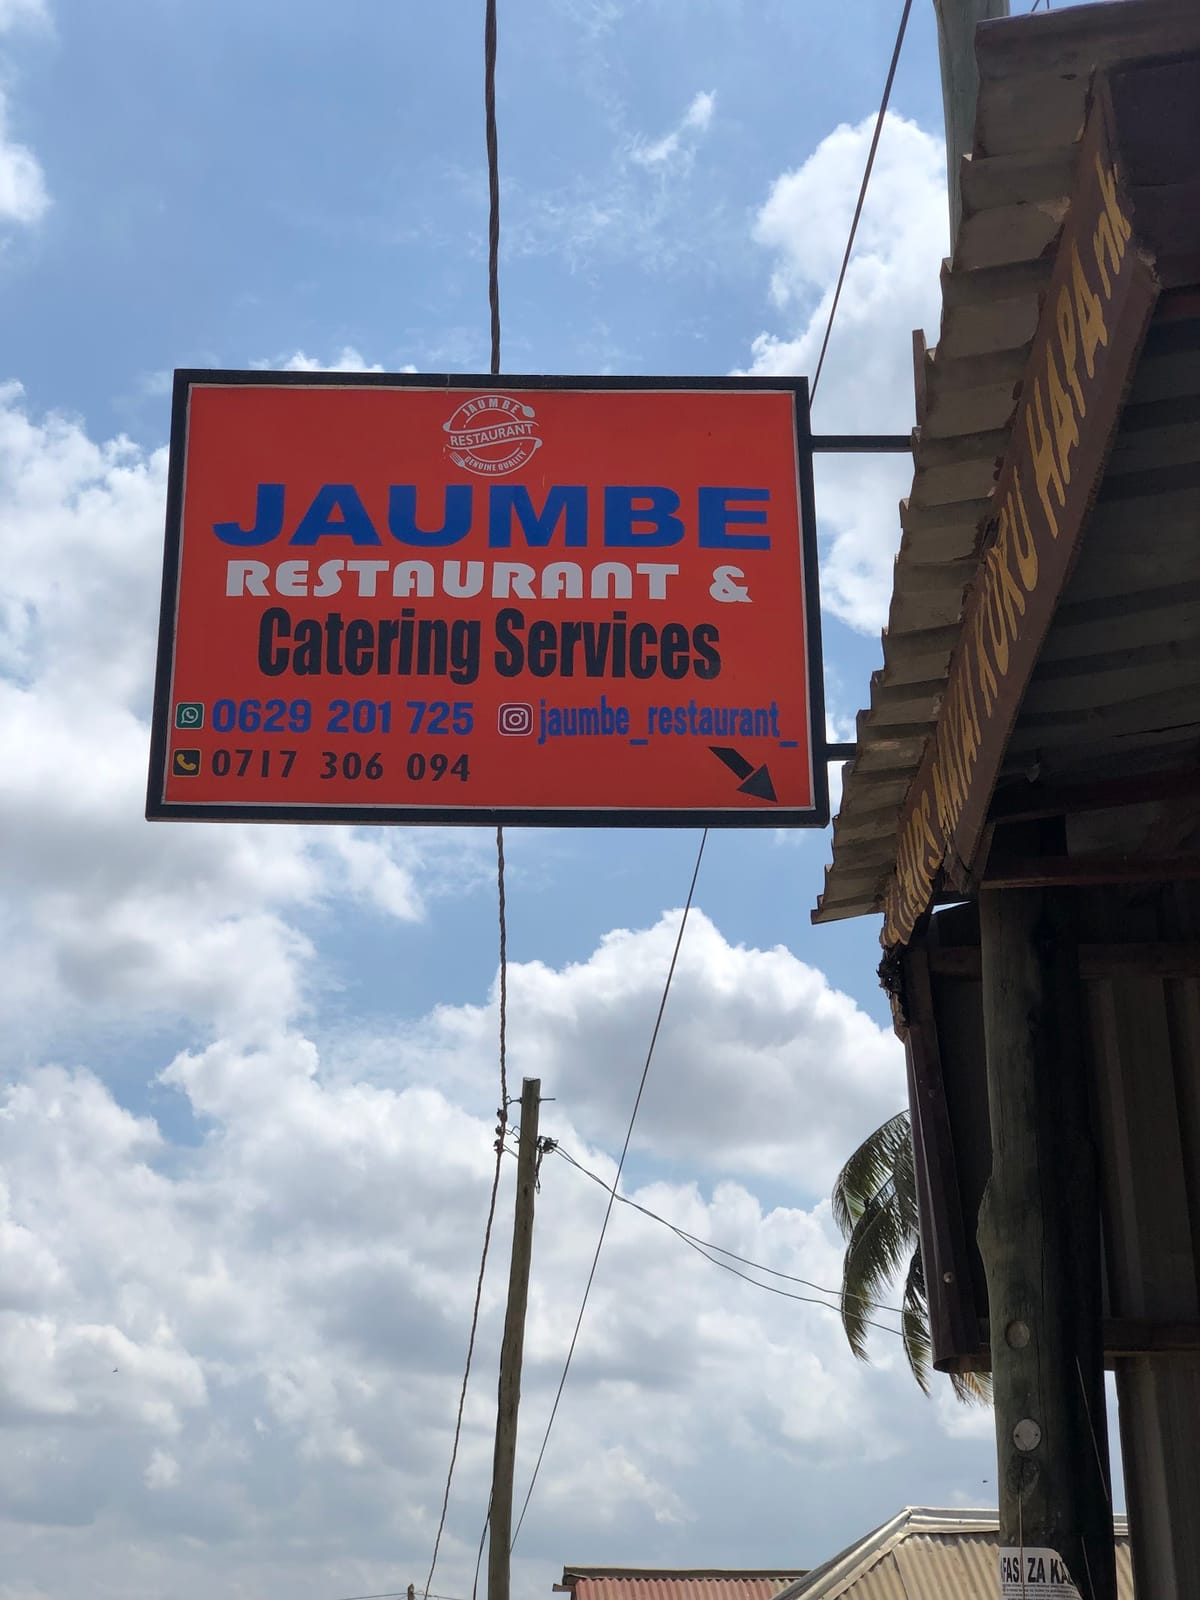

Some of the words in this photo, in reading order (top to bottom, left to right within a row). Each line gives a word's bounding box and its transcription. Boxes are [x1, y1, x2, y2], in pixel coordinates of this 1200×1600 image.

[462, 398, 520, 417] JAUMBE
[450, 423, 534, 447] RESTAURANT
[464, 456, 496, 472] GENUINE
[498, 450, 527, 471] QUALITY
[974, 464, 1038, 720] KUKU
[1026, 236, 1108, 540] HAPA
[213, 483, 771, 550] JAUMBE
[226, 559, 679, 600] RESTAURANT
[709, 566, 753, 603] &
[258, 607, 481, 685] Catering
[494, 608, 721, 679] Services
[213, 699, 311, 734] 0629
[327, 699, 391, 733] 201
[407, 702, 474, 735] 725
[537, 696, 798, 747] jaumbe_restaurant_
[212, 749, 296, 778] 0717
[320, 751, 384, 780] 306
[406, 753, 470, 782] 094
[1027, 1557, 1046, 1583] ZA
[1050, 1558, 1072, 1584] KA
